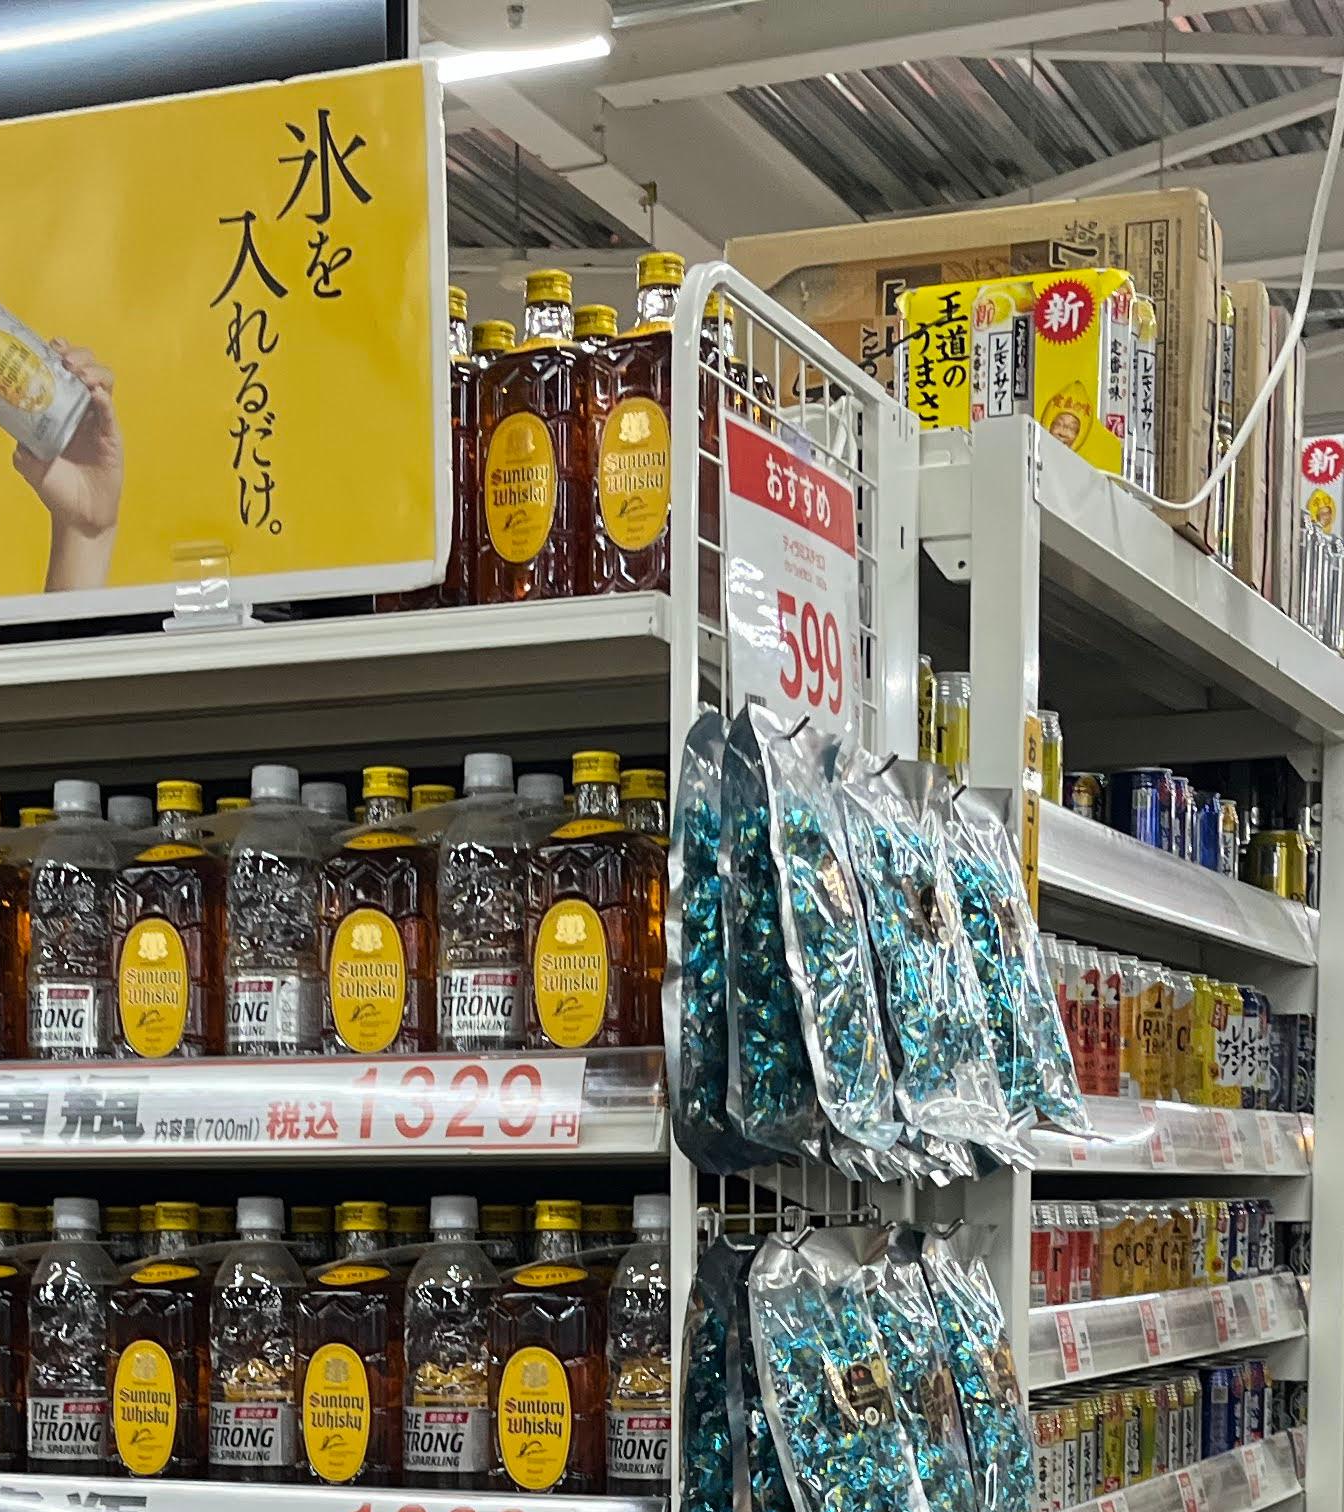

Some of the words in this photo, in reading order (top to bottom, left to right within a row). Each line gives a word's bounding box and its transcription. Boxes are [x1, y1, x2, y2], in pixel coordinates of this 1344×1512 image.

[276, 109, 372, 299] 氷を
[1043, 290, 1085, 333] 新
[935, 290, 970, 388] 王道の
[209, 210, 289, 536] 入れるだけ。
[993, 338, 1010, 412] レモンサワー
[604, 449, 666, 473] Suntory
[1307, 446, 1340, 479] 新
[490, 464, 549, 487] Suntory
[606, 470, 665, 494] Whisky
[493, 482, 548, 507] Whisky
[765, 453, 831, 528] おすすめ
[777, 589, 843, 715] 599
[336, 961, 398, 983] Suntory
[540, 952, 601, 974] Suntory
[125, 969, 181, 990] Suntory
[338, 979, 397, 1001] Whisky
[443, 976, 469, 994] THE
[542, 972, 600, 996] Whisky
[127, 988, 179, 1008] Whisky
[441, 996, 513, 1018] STRONG
[266, 1100, 338, 1141] 税込
[119, 1387, 171, 1408] Suntory
[309, 1391, 365, 1413] Suntory
[504, 1397, 564, 1419] Suntory
[121, 1406, 169, 1427] Whisky
[311, 1410, 363, 1432] Whisky
[507, 1416, 562, 1438] Whisky
[32, 1421, 102, 1442] STRONG
[211, 1427, 273, 1449] STRONG
[405, 1431, 464, 1453] TRONG
[608, 1438, 667, 1460] TRONG
